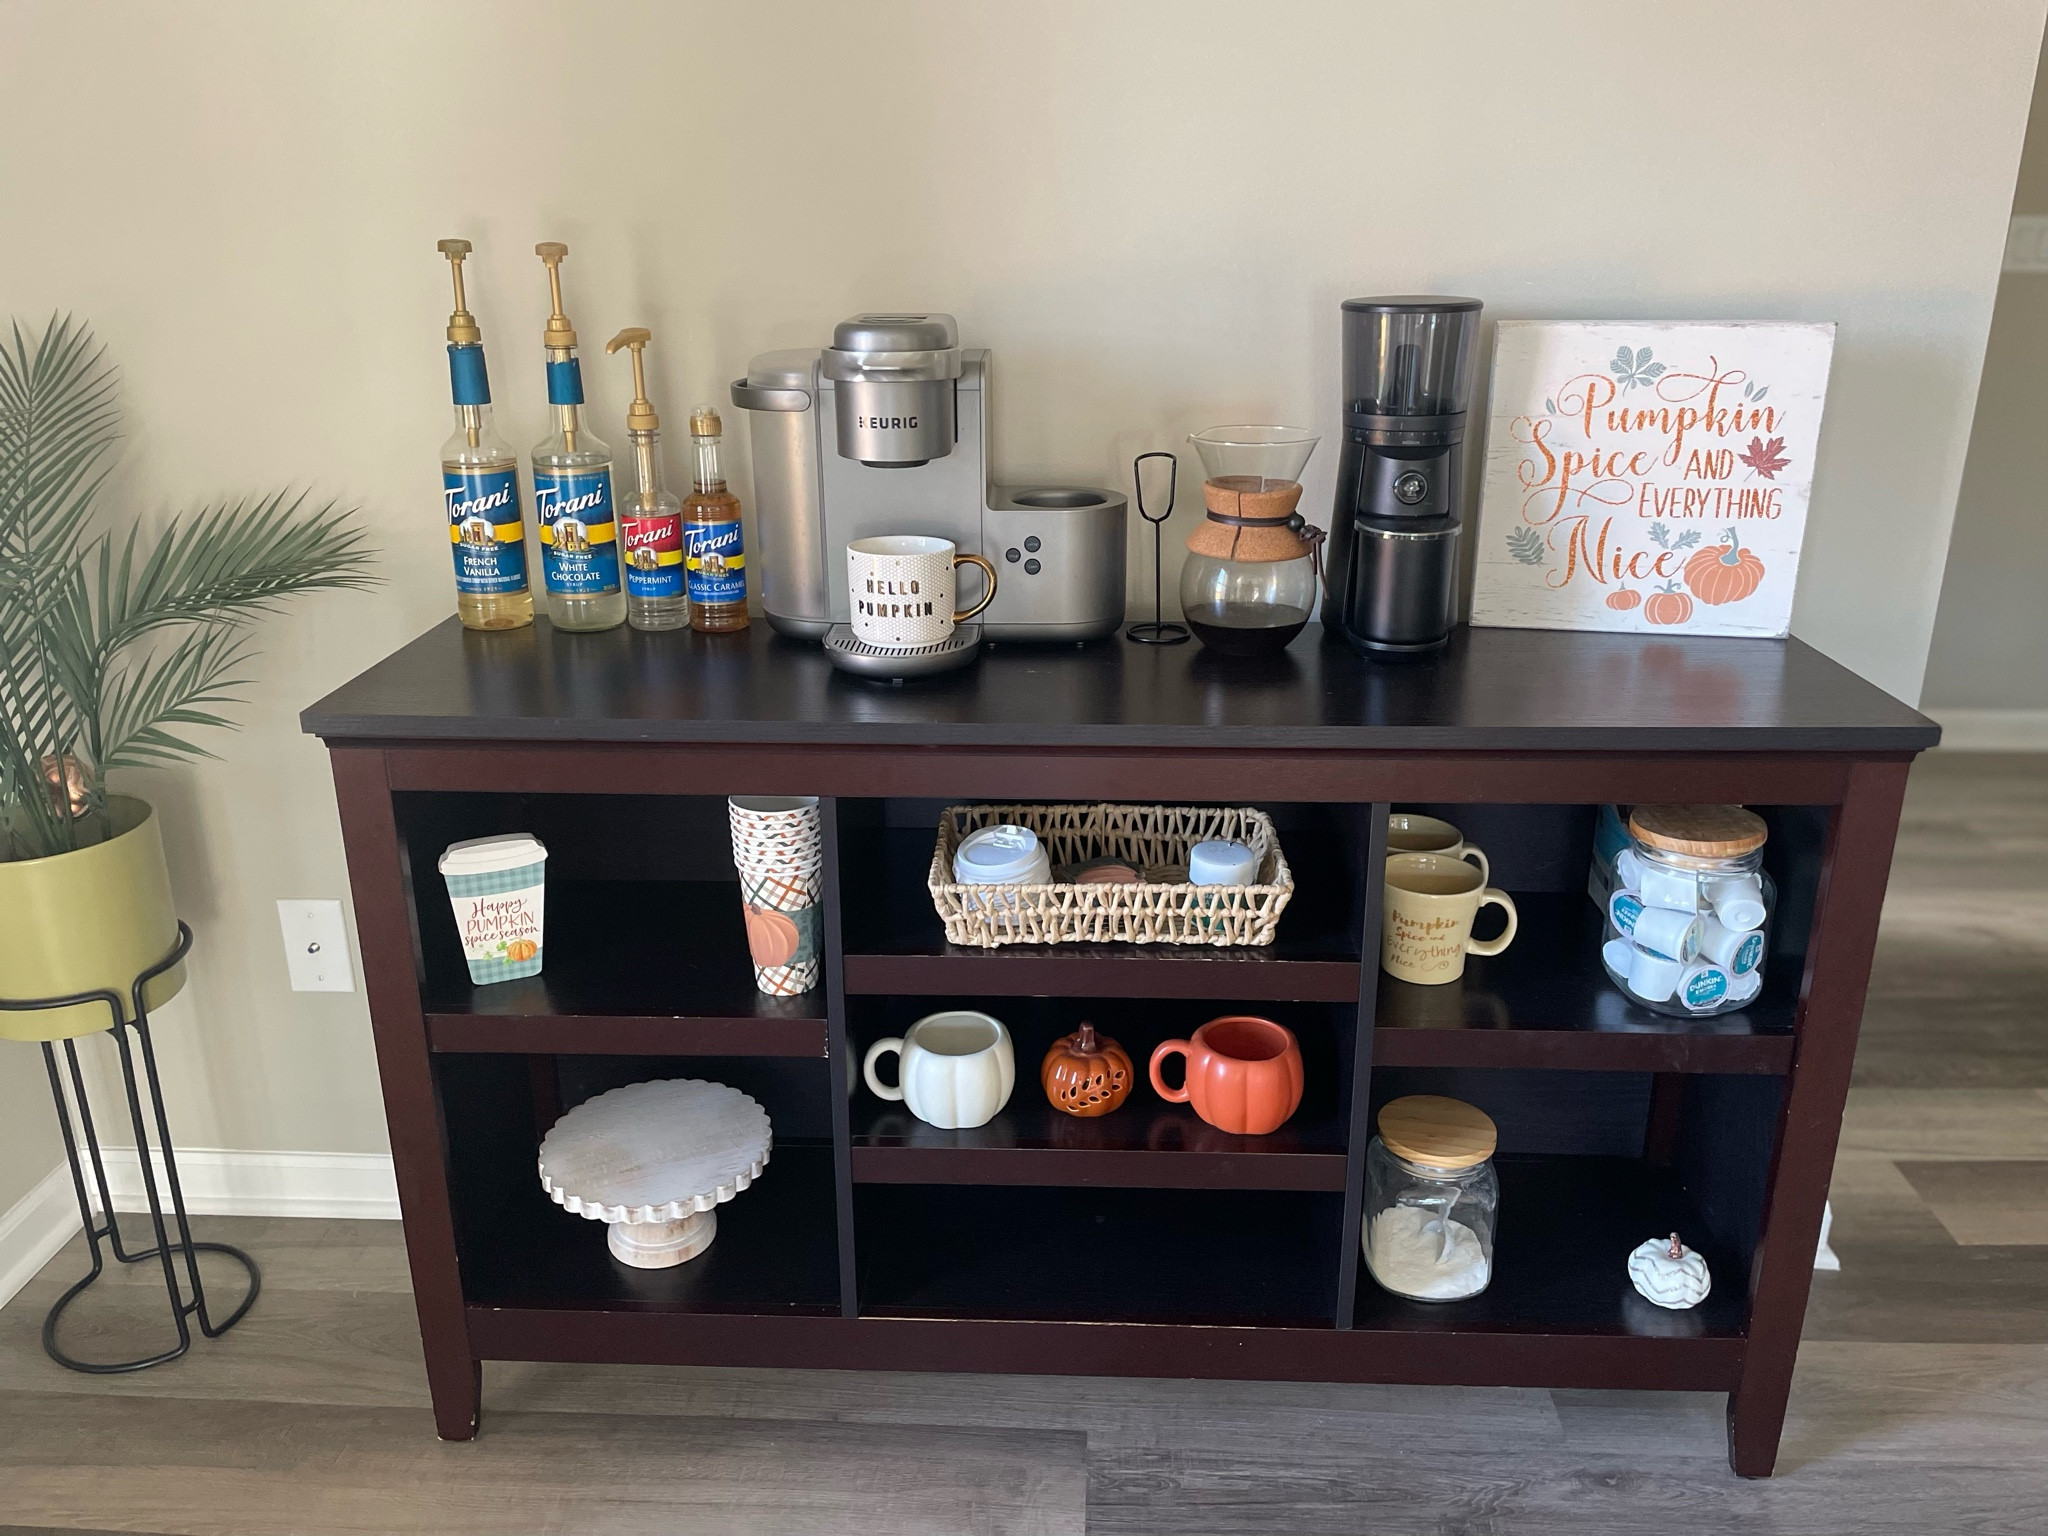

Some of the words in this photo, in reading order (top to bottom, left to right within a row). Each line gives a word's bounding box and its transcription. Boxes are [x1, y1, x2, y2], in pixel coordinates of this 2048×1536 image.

[1556, 355, 1786, 467] Pumpkin
[859, 416, 918, 429] KEURIG
[1510, 415, 1658, 526] Spice
[1683, 448, 1734, 481] AND
[444, 482, 510, 526] Torani
[536, 483, 603, 527] Torani
[1639, 483, 1783, 519] EVERYTHING
[459, 542, 480, 551] SUGAR
[621, 519, 673, 554] Torani
[685, 524, 739, 561] Torani
[463, 556, 497, 566] FRENCH
[553, 551, 574, 559] SUGAR
[1545, 515, 1686, 589] Nice
[463, 567, 500, 576] VANILLA
[551, 571, 601, 582] CHOCOLATE
[558, 562, 588, 572] WHITE
[628, 573, 672, 584] PEPPERMINT
[688, 580, 712, 592] CLASSIC
[713, 580, 745, 592] CARAMEL
[866, 578, 920, 595] HELLO
[858, 600, 933, 618] PUMPKIN
[471, 897, 528, 919] Happy
[466, 911, 534, 935] PUMPKIN
[1391, 909, 1458, 935] Pumpkin
[464, 931, 499, 948] spice
[499, 925, 541, 941] season
[1395, 926, 1425, 941] Spice
[1386, 935, 1461, 961] Everything
[1389, 954, 1416, 968] Nice
